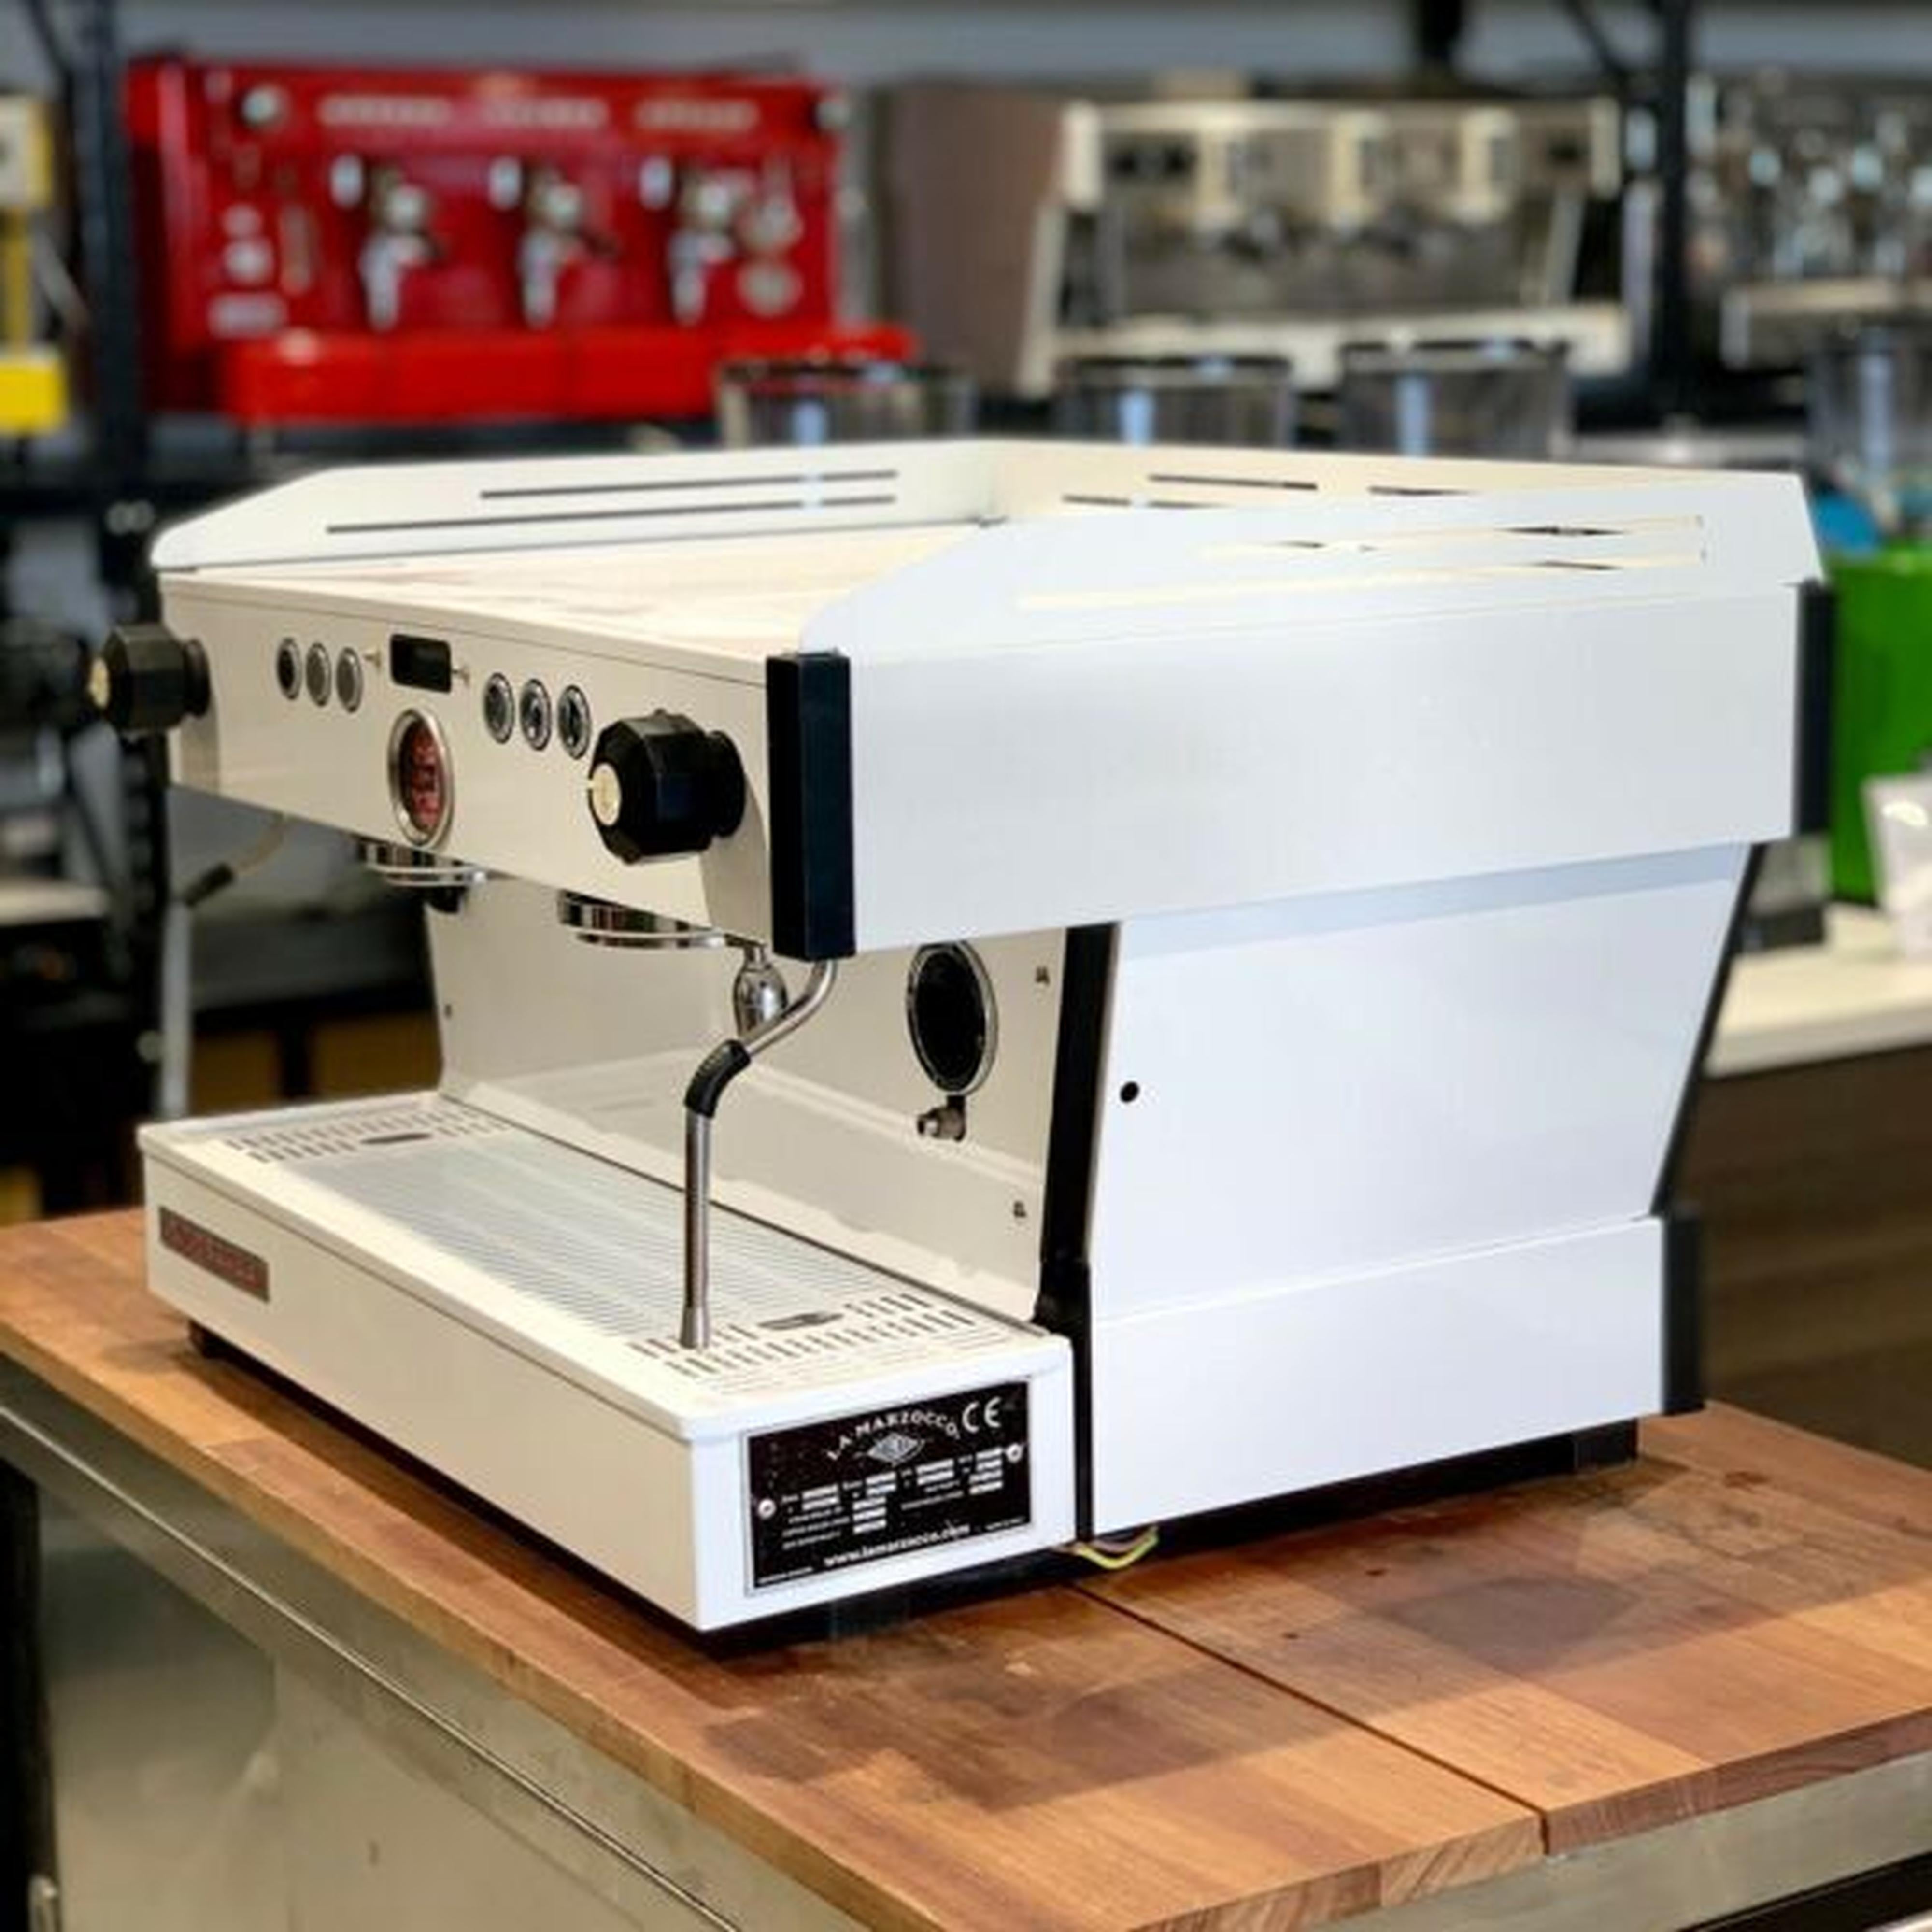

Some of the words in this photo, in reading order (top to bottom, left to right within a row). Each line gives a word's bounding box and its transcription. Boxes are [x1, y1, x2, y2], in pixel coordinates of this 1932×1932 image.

[827, 1435, 852, 1461] LA
[855, 1410, 957, 1437] MARZOCCO
[962, 1396, 1002, 1433] CE
